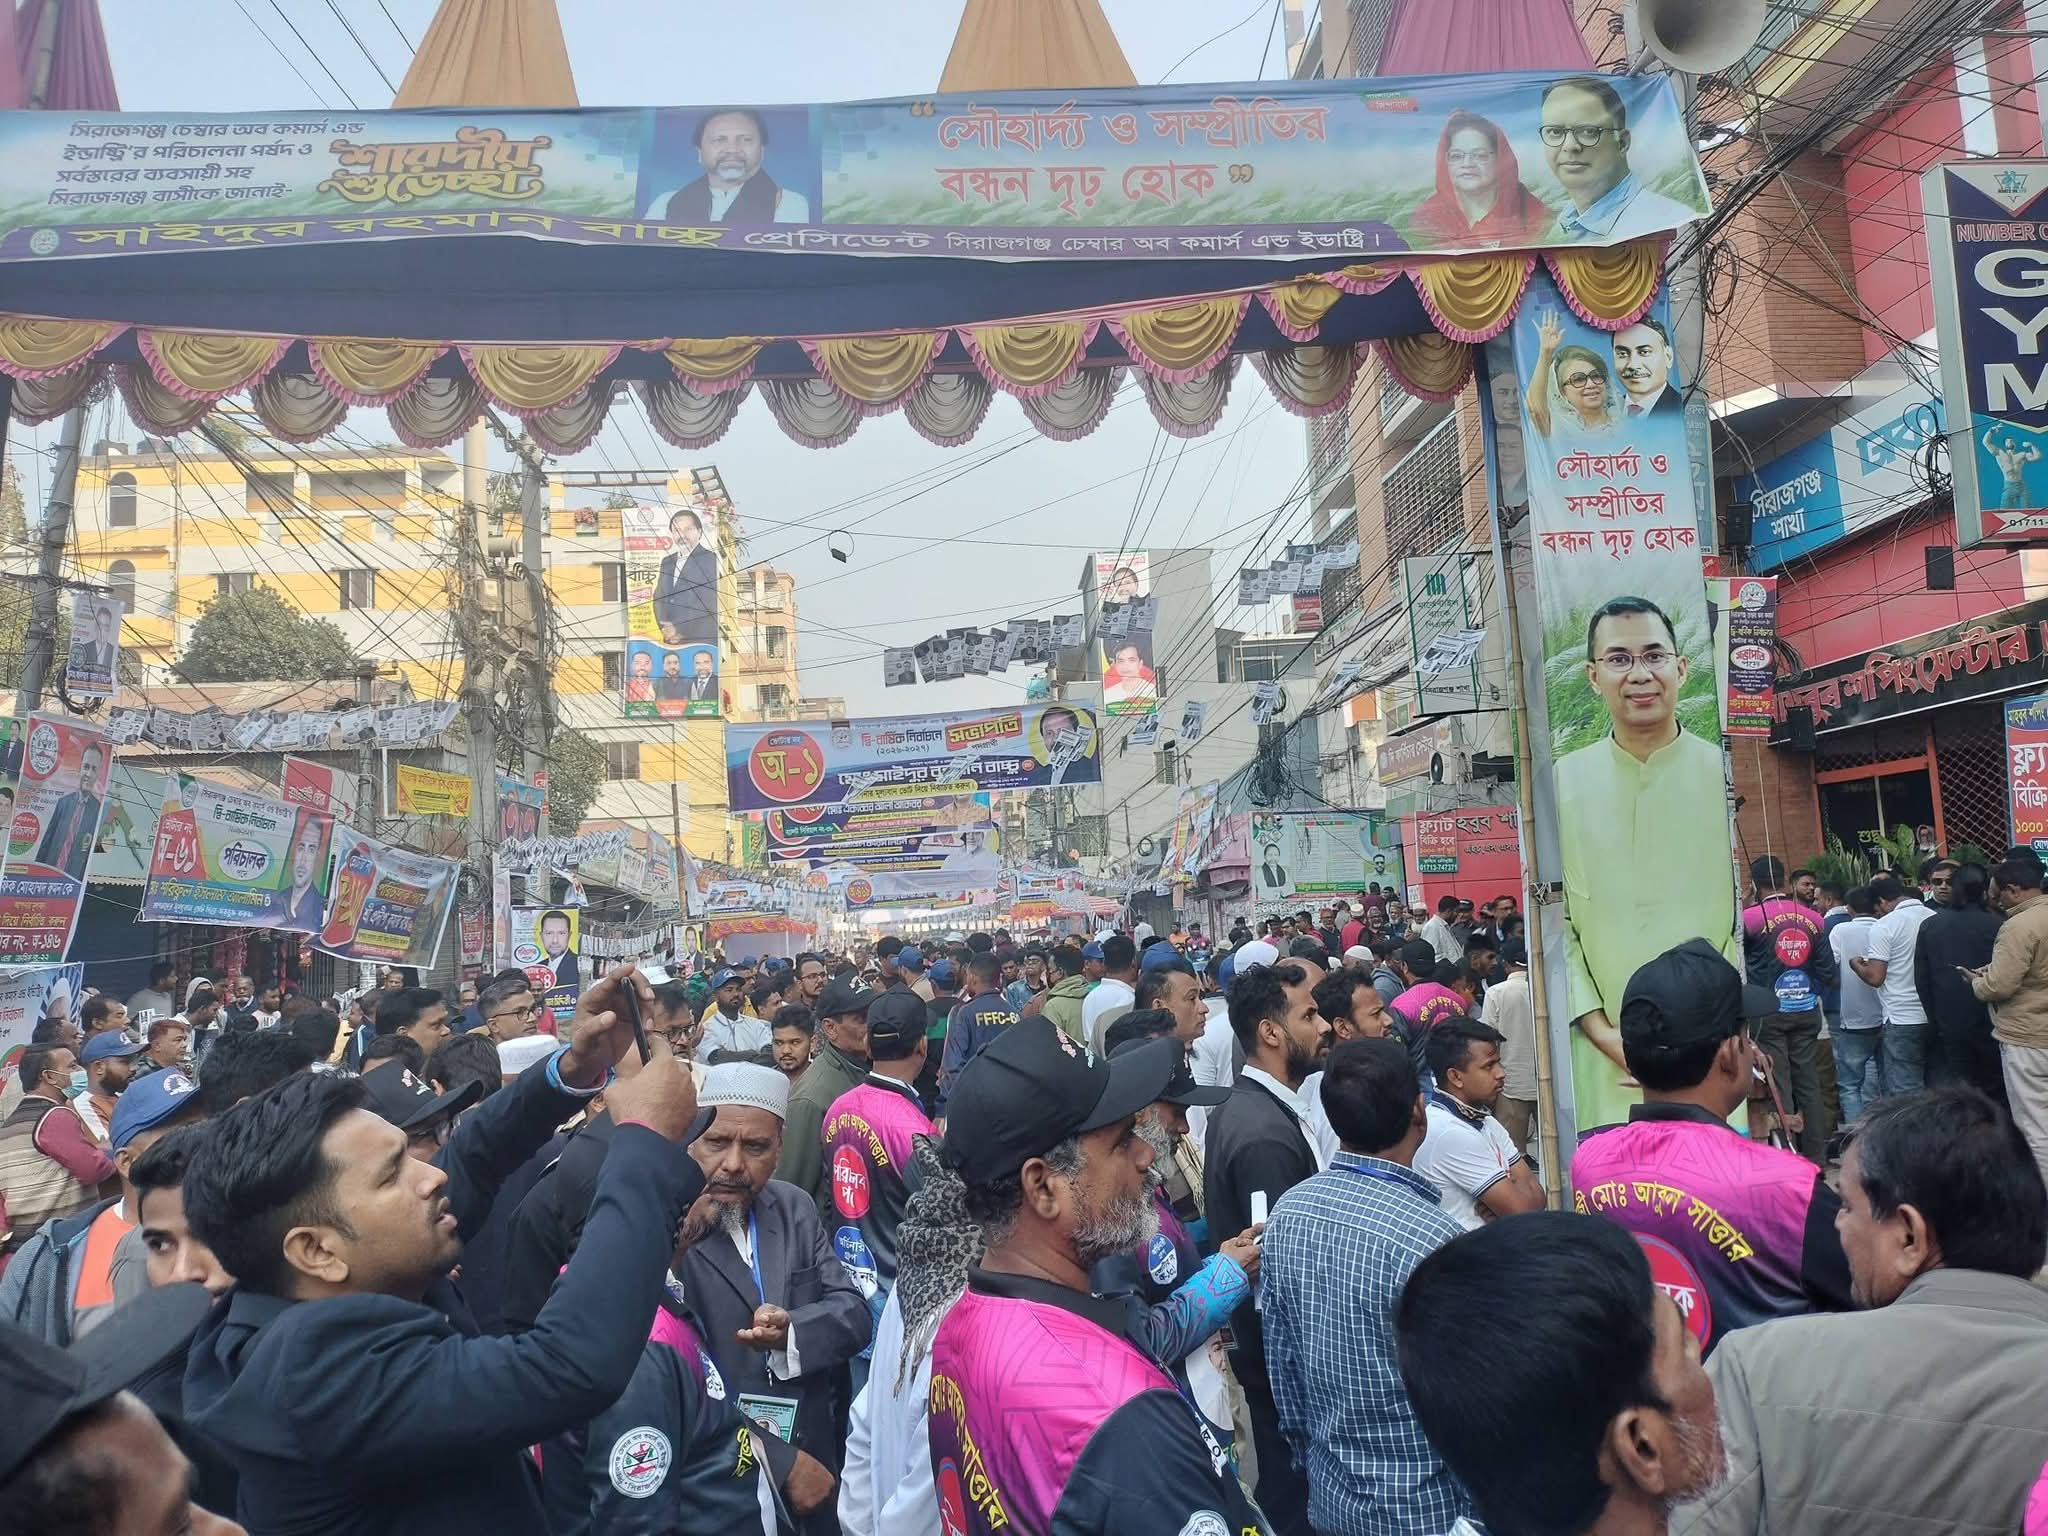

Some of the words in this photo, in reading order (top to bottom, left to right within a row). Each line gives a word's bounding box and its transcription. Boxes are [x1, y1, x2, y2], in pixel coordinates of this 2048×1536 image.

[69, 120, 165, 138] সিরাজগঞ্জ
[172, 122, 227, 138] চেম্বার
[232, 123, 268, 136] অব
[273, 119, 329, 136] কমার্স
[1103, 112, 1140, 145] ও
[1149, 97, 1330, 149] সম্প্রীতির
[152, 141, 245, 158] পরিচালনা
[250, 139, 293, 158] পর্ষদ
[297, 144, 314, 157] ও
[329, 126, 552, 174] শারদীয়
[56, 165, 138, 184] সর্বস্তরের
[144, 162, 221, 181] ব্যবসায়ী
[224, 165, 255, 181] সহ
[317, 165, 545, 203] শুভেচ্ছা
[48, 188, 147, 206] সিরাজগঞ্জ
[152, 185, 220, 202] বাসীকে
[936, 165, 1036, 205] বন্ধন
[1044, 164, 1106, 220] দৃঢ়
[64, 219, 311, 249] সাইদুর
[328, 207, 568, 236] রহমান
[573, 220, 733, 248] বাচ্চু
[744, 228, 934, 249] প্রেসিডেন্ট
[946, 231, 1051, 252] সিরাজগঞ্জ
[1062, 236, 1125, 253] চেম্বার
[1132, 237, 1171, 252] অব
[1180, 230, 1243, 252] কমার্স
[1956, 223, 2036, 242] NUMBER
[1557, 444, 1641, 480] সৌহার্দ্য
[1648, 453, 1668, 474] ও
[1564, 486, 1667, 520] সম্প্রীতির
[1750, 467, 1823, 523] সিরাজগঞ্জ
[1770, 508, 1807, 539] শাখা
[1539, 531, 1595, 554] বন্ধন
[1600, 528, 1636, 561] দৃঢ়
[1643, 524, 1697, 552] হোক
[1916, 625, 2031, 694] সেন্টার
[905, 728, 942, 744] নির্বাচনে
[947, 714, 1020, 744] সভাপতি
[756, 748, 819, 787] অ-১
[1418, 816, 1455, 834] ফ্ল্যাট
[2015, 818, 2044, 833] ১০০০
[224, 842, 268, 870] পরিচালক
[1591, 1180, 1627, 1212] মোঃ
[1687, 1195, 1754, 1263] সাত্তার
[962, 1424, 1009, 1530] সাত্তার
